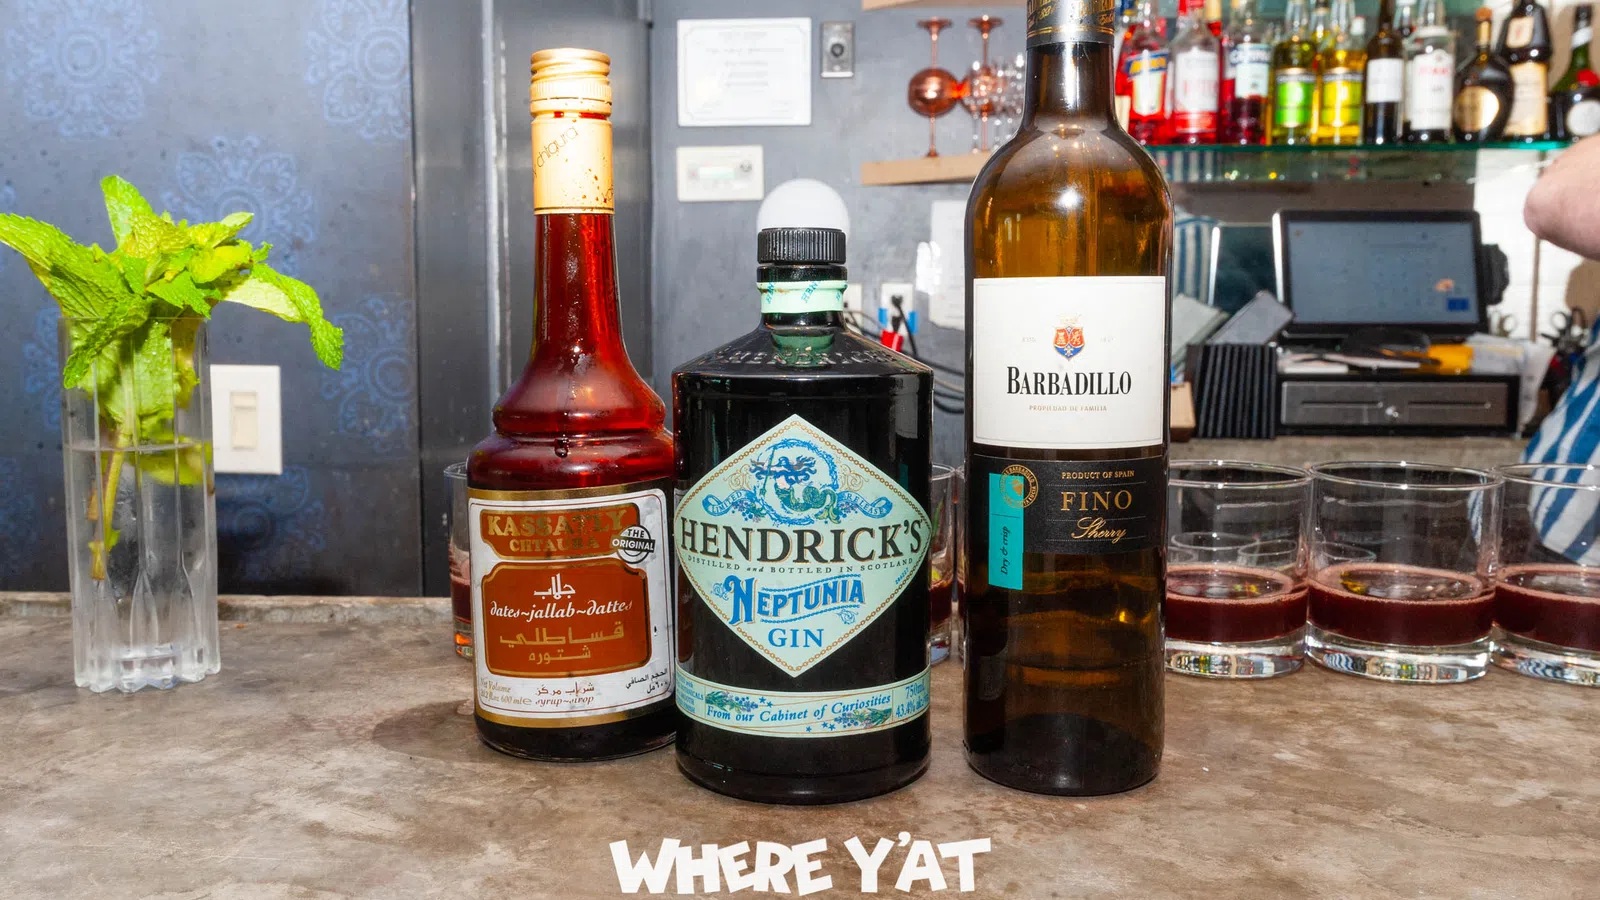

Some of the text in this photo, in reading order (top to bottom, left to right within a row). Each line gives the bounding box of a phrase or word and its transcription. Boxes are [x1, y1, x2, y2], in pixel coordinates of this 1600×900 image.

[1007, 366, 1132, 395] BARBADILLO
[1029, 404, 1107, 412] PROPIEDAD DE FAMILIA
[1061, 470, 1135, 480] PRODUCT OF SPAIN
[711, 492, 743, 514] LIMITED
[845, 492, 885, 515] RELEASE
[1061, 490, 1132, 511] FINO
[627, 528, 645, 539] THE
[680, 517, 923, 564] HENDRICK'S
[1001, 526, 1010, 546] crisp
[1071, 517, 1127, 544] Sherry
[612, 538, 655, 552] ORIGINAL
[687, 555, 913, 574] DISTILLED and BOTTLED IN SCOTLAND
[1000, 557, 1010, 576] Dry
[533, 573, 576, 600] جلاب
[768, 628, 824, 648] GIN
[707, 704, 731, 722] From
[736, 711, 755, 722] our
[760, 708, 808, 722] Cabinet
[814, 703, 827, 719] of
[832, 694, 891, 714] Curiosities
